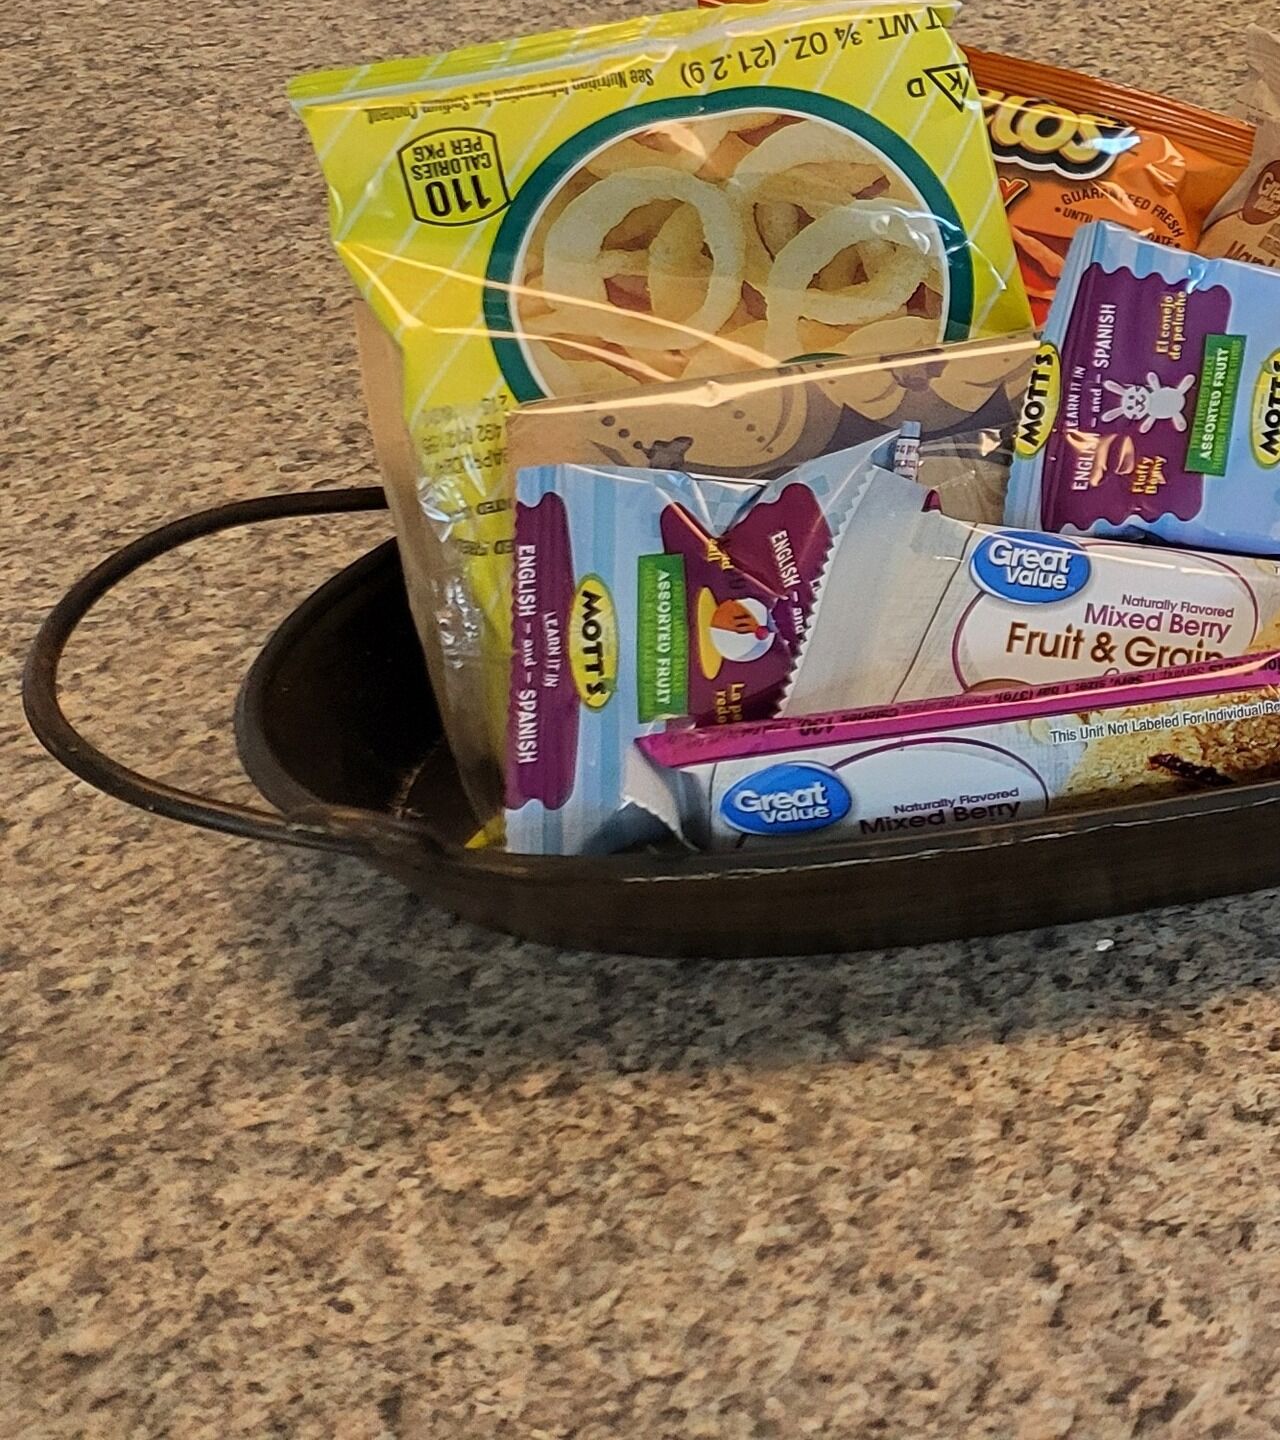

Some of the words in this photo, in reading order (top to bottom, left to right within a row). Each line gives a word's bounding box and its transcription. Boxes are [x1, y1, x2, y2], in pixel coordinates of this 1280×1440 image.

[784, 32, 828, 60] OZ.
[571, 69, 627, 97] Nutrition
[629, 66, 654, 88] See
[412, 141, 447, 160] PKG
[450, 136, 482, 154] PER
[411, 152, 492, 181] CALORIES
[425, 175, 492, 217] 110
[1151, 205, 1186, 237] FRESH
[1157, 293, 1177, 340] conejo
[1092, 302, 1118, 369] SPANISH
[1155, 340, 1169, 354] El
[1167, 343, 1182, 361] de
[1072, 365, 1087, 379] IN
[1211, 346, 1230, 388] FRUIT
[1088, 387, 1104, 413] and
[1200, 388, 1223, 460] ASSORTED
[1131, 454, 1153, 494] Fluffy
[770, 530, 801, 587] ENGLISH
[987, 539, 1071, 574] Great
[517, 545, 537, 616] ENGLISH
[1005, 567, 1068, 590] Value
[656, 569, 672, 653] ASSORTED
[1121, 594, 1178, 613] Naturally
[1180, 599, 1234, 619] Flavored
[543, 611, 561, 656] LEARN
[1084, 603, 1162, 633] Mixed
[1169, 614, 1232, 643] Berry
[523, 639, 537, 666] and
[1005, 622, 1085, 659] Fruit
[1090, 632, 1115, 664] &
[546, 659, 560, 670] IT
[544, 673, 560, 689] IN
[656, 657, 671, 705] FRUIT
[731, 683, 745, 701] La
[516, 689, 538, 766] SPANISH
[1050, 728, 1077, 744] This
[1080, 724, 1105, 740] Unit
[1108, 721, 1128, 736] Not
[1131, 715, 1180, 733] Labeled
[734, 781, 829, 813] Great
[893, 793, 956, 816] Naturally
[959, 787, 1019, 804] Flavored
[761, 804, 830, 824] Value
[859, 807, 946, 836] Mixed
[954, 800, 1021, 822] Berry
